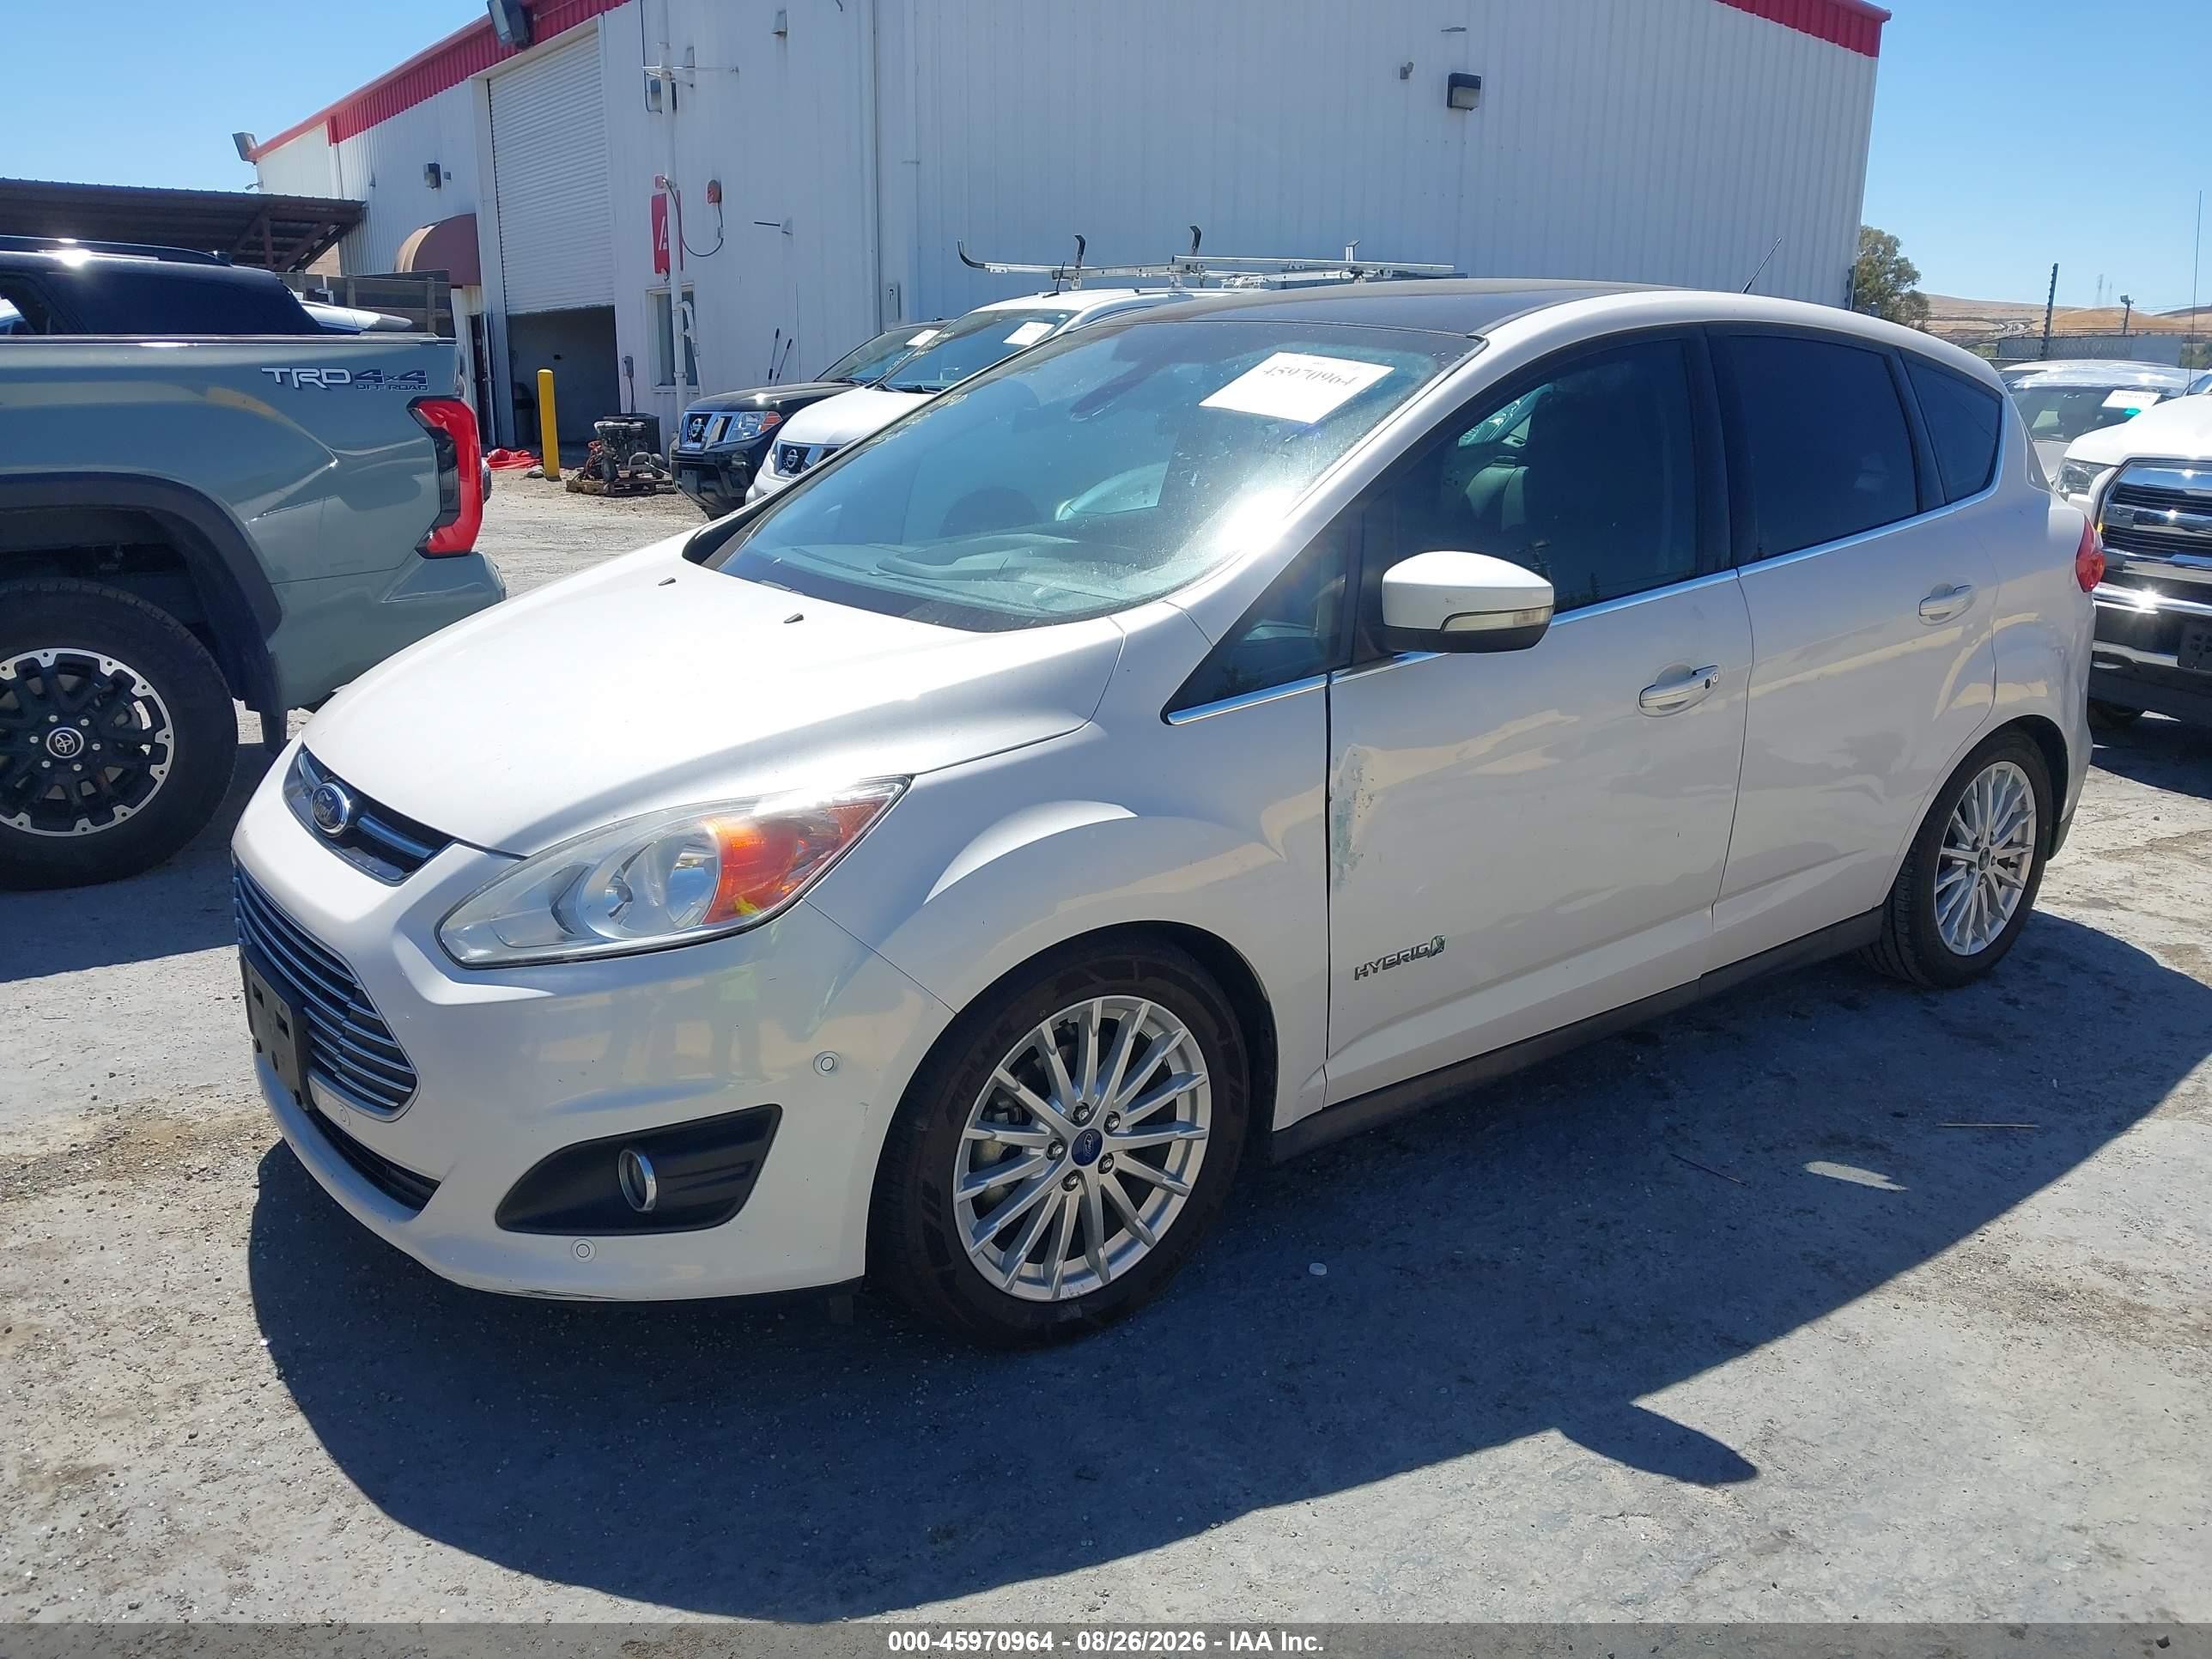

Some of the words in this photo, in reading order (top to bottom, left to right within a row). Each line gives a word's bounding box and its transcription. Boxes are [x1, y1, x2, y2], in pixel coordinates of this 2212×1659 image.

[261, 368, 351, 389] TRD
[1263, 366, 1361, 386] 45970964
[313, 787, 337, 819] Ford
[1354, 942, 1431, 981] HYBRID
